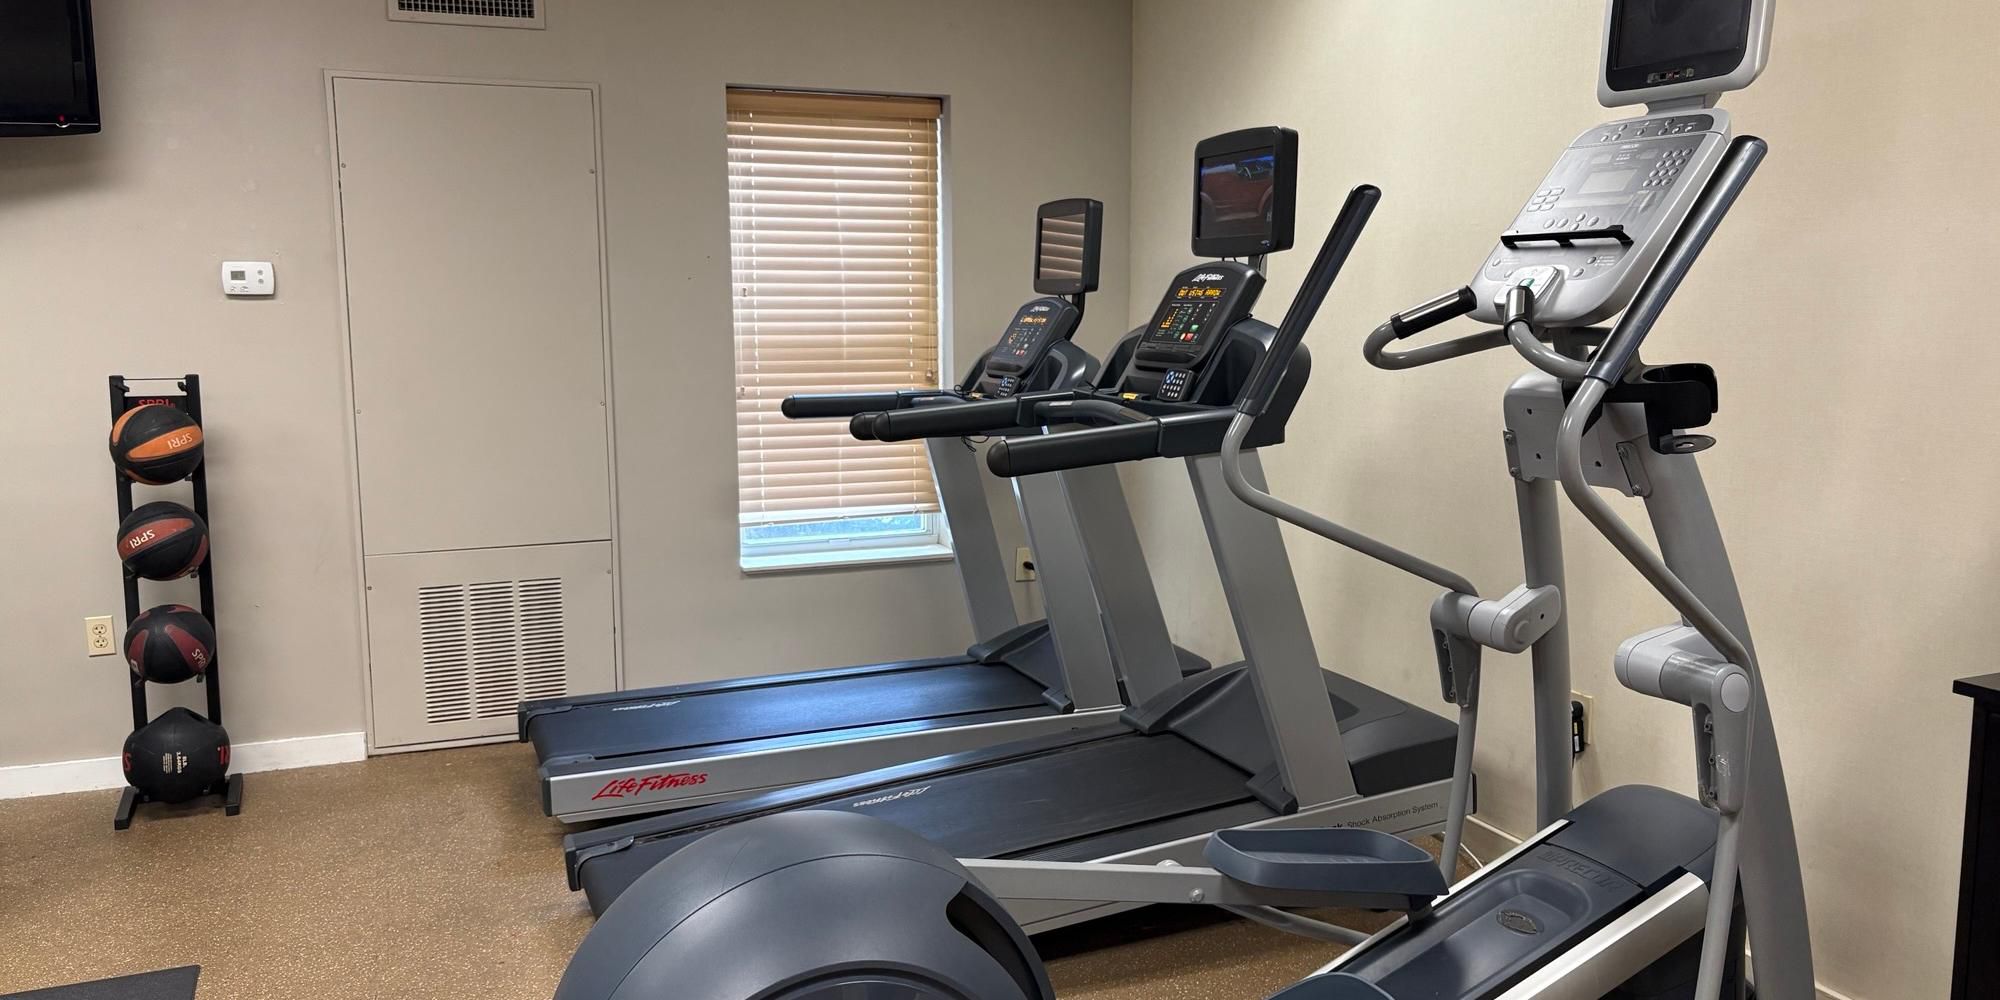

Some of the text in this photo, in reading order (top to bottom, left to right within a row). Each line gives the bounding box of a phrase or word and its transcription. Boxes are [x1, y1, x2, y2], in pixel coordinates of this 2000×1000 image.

[167, 432, 193, 449] SPRI
[129, 529, 155, 549] SPRI
[1347, 818, 1370, 828] Shock
[1372, 808, 1411, 823] Absorption
[1412, 801, 1439, 815] System
